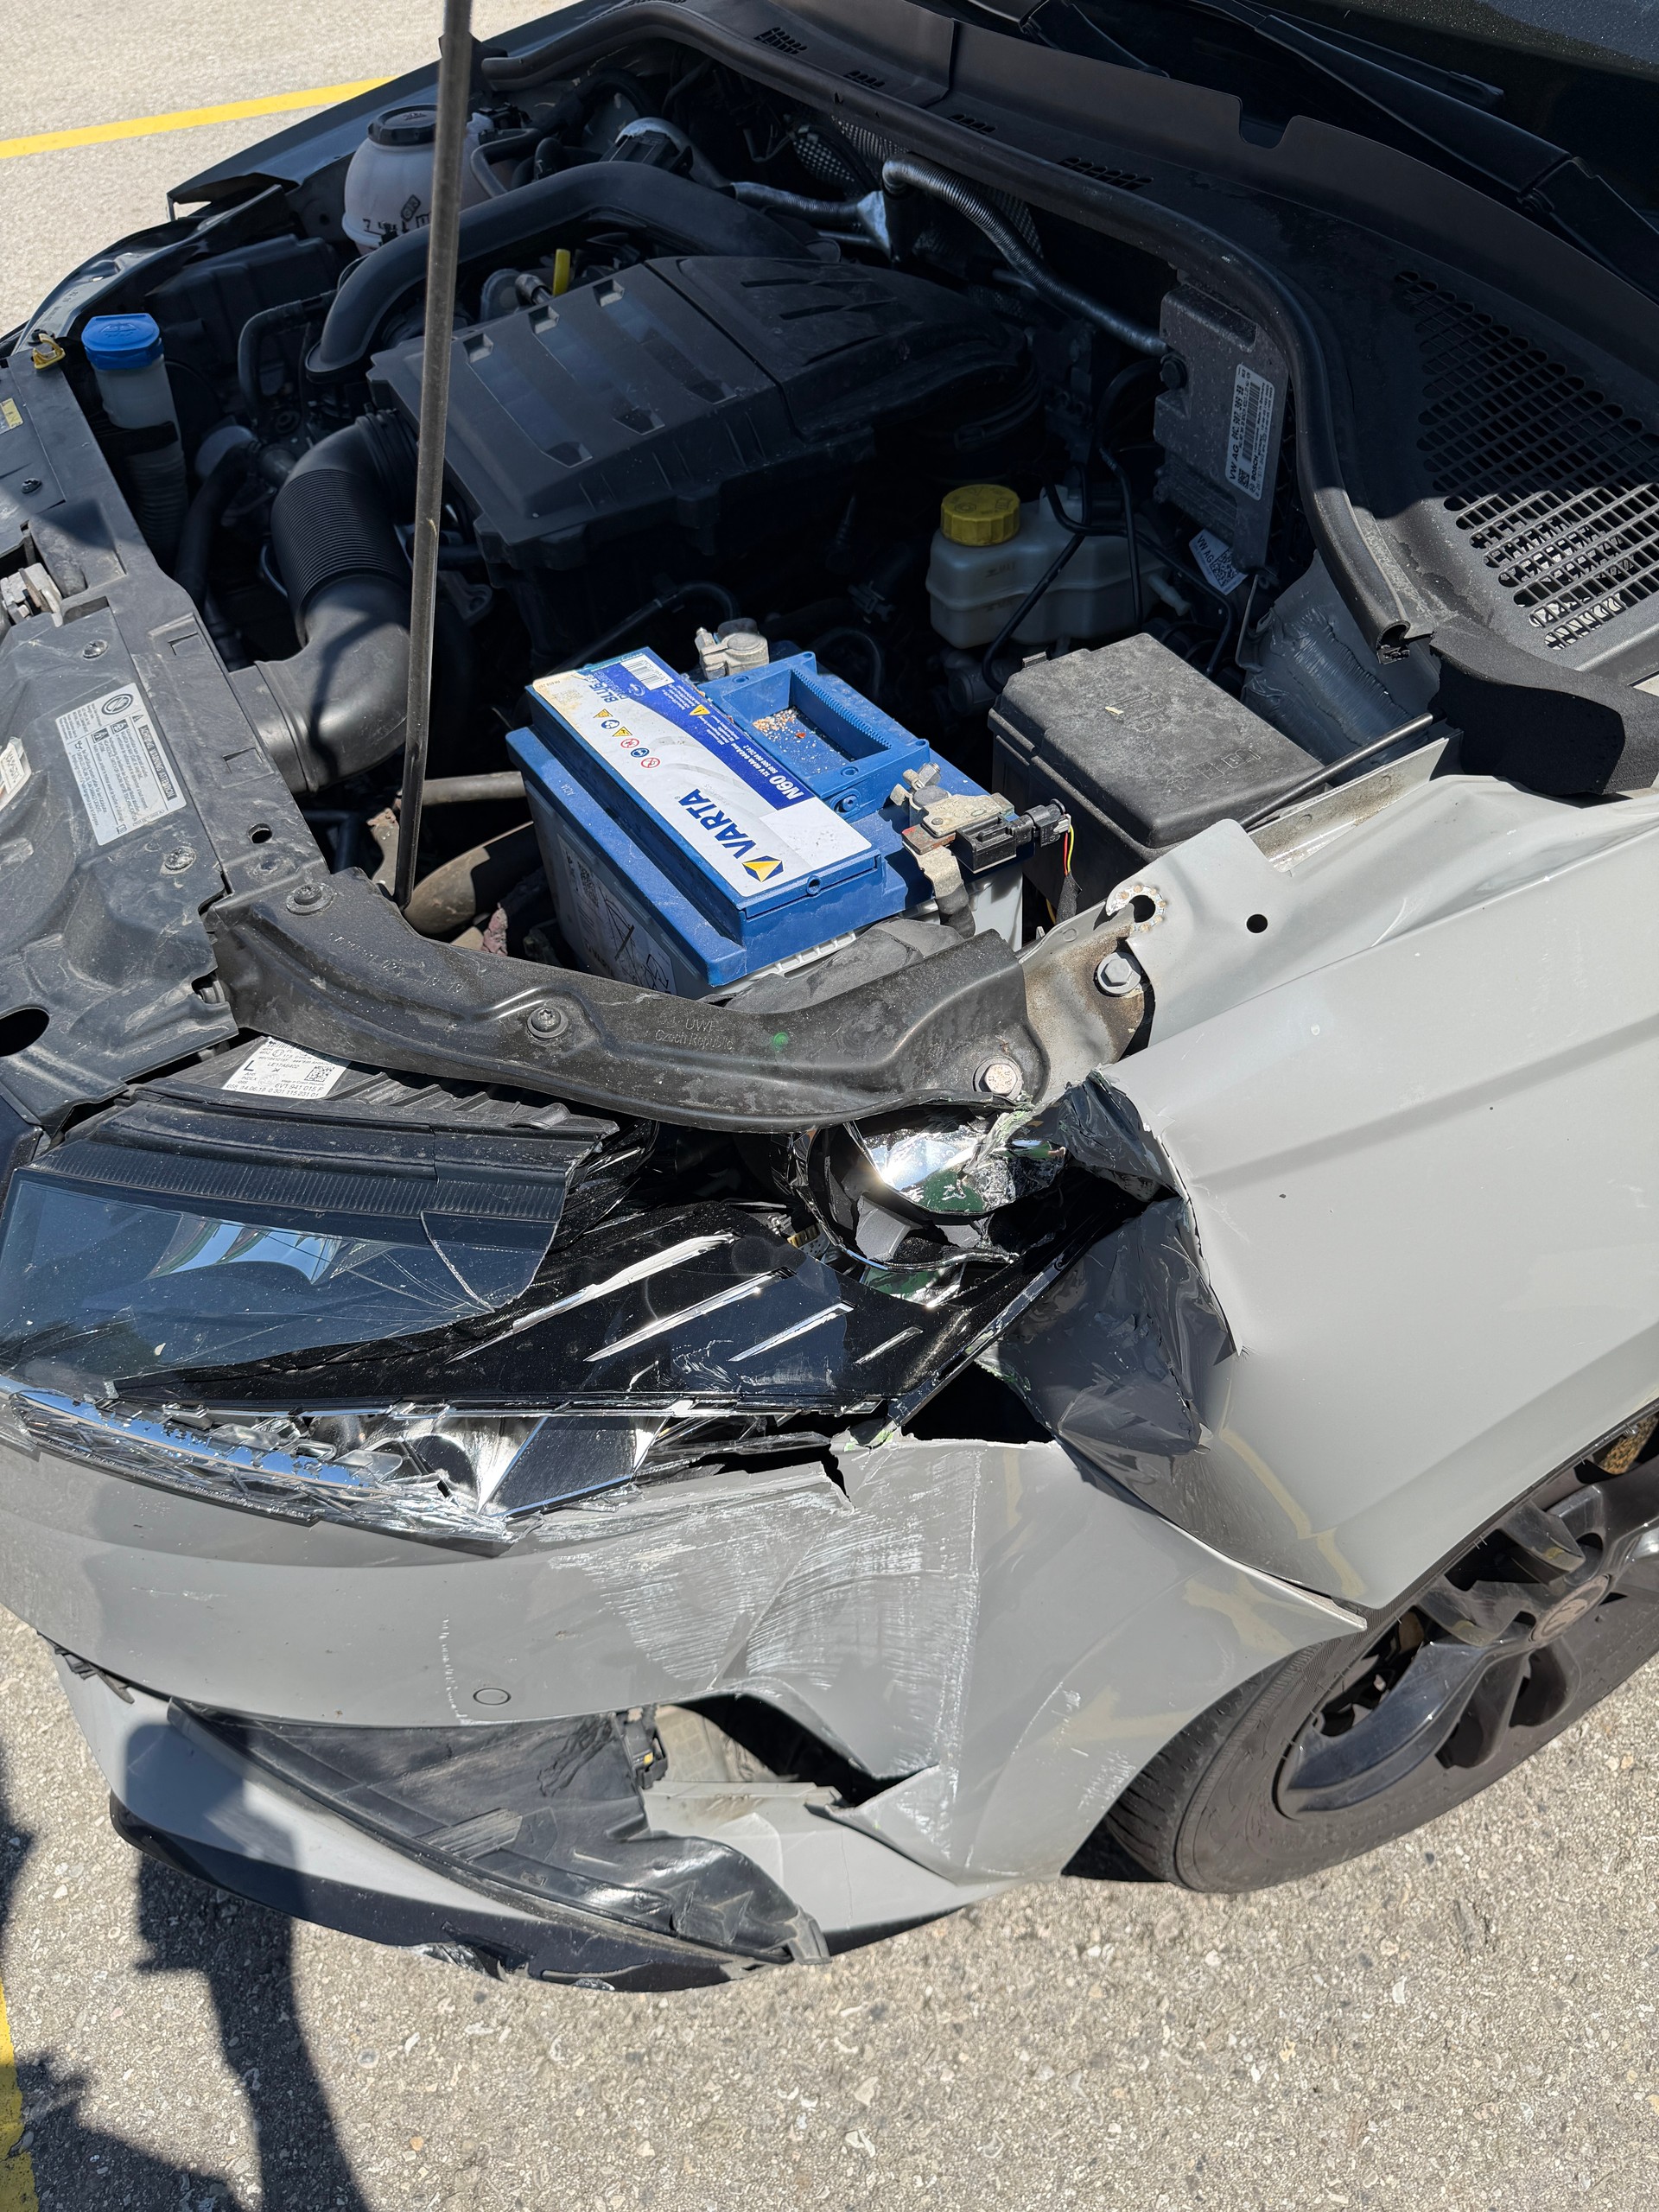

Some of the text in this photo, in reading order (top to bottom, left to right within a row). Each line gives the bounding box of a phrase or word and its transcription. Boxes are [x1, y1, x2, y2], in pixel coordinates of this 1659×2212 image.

[1233, 444, 1239, 461] AG
[1230, 461, 1237, 480] VW
[1197, 536, 1214, 563] VW AG
[588, 682, 619, 703] BLUE
[139, 726, 175, 798] ACHTUNG WARNING ATTENTION
[769, 775, 804, 799] N60
[677, 788, 757, 859] VARTA
[655, 1029, 734, 1051] Czech Republic
[244, 1060, 254, 1071] L
